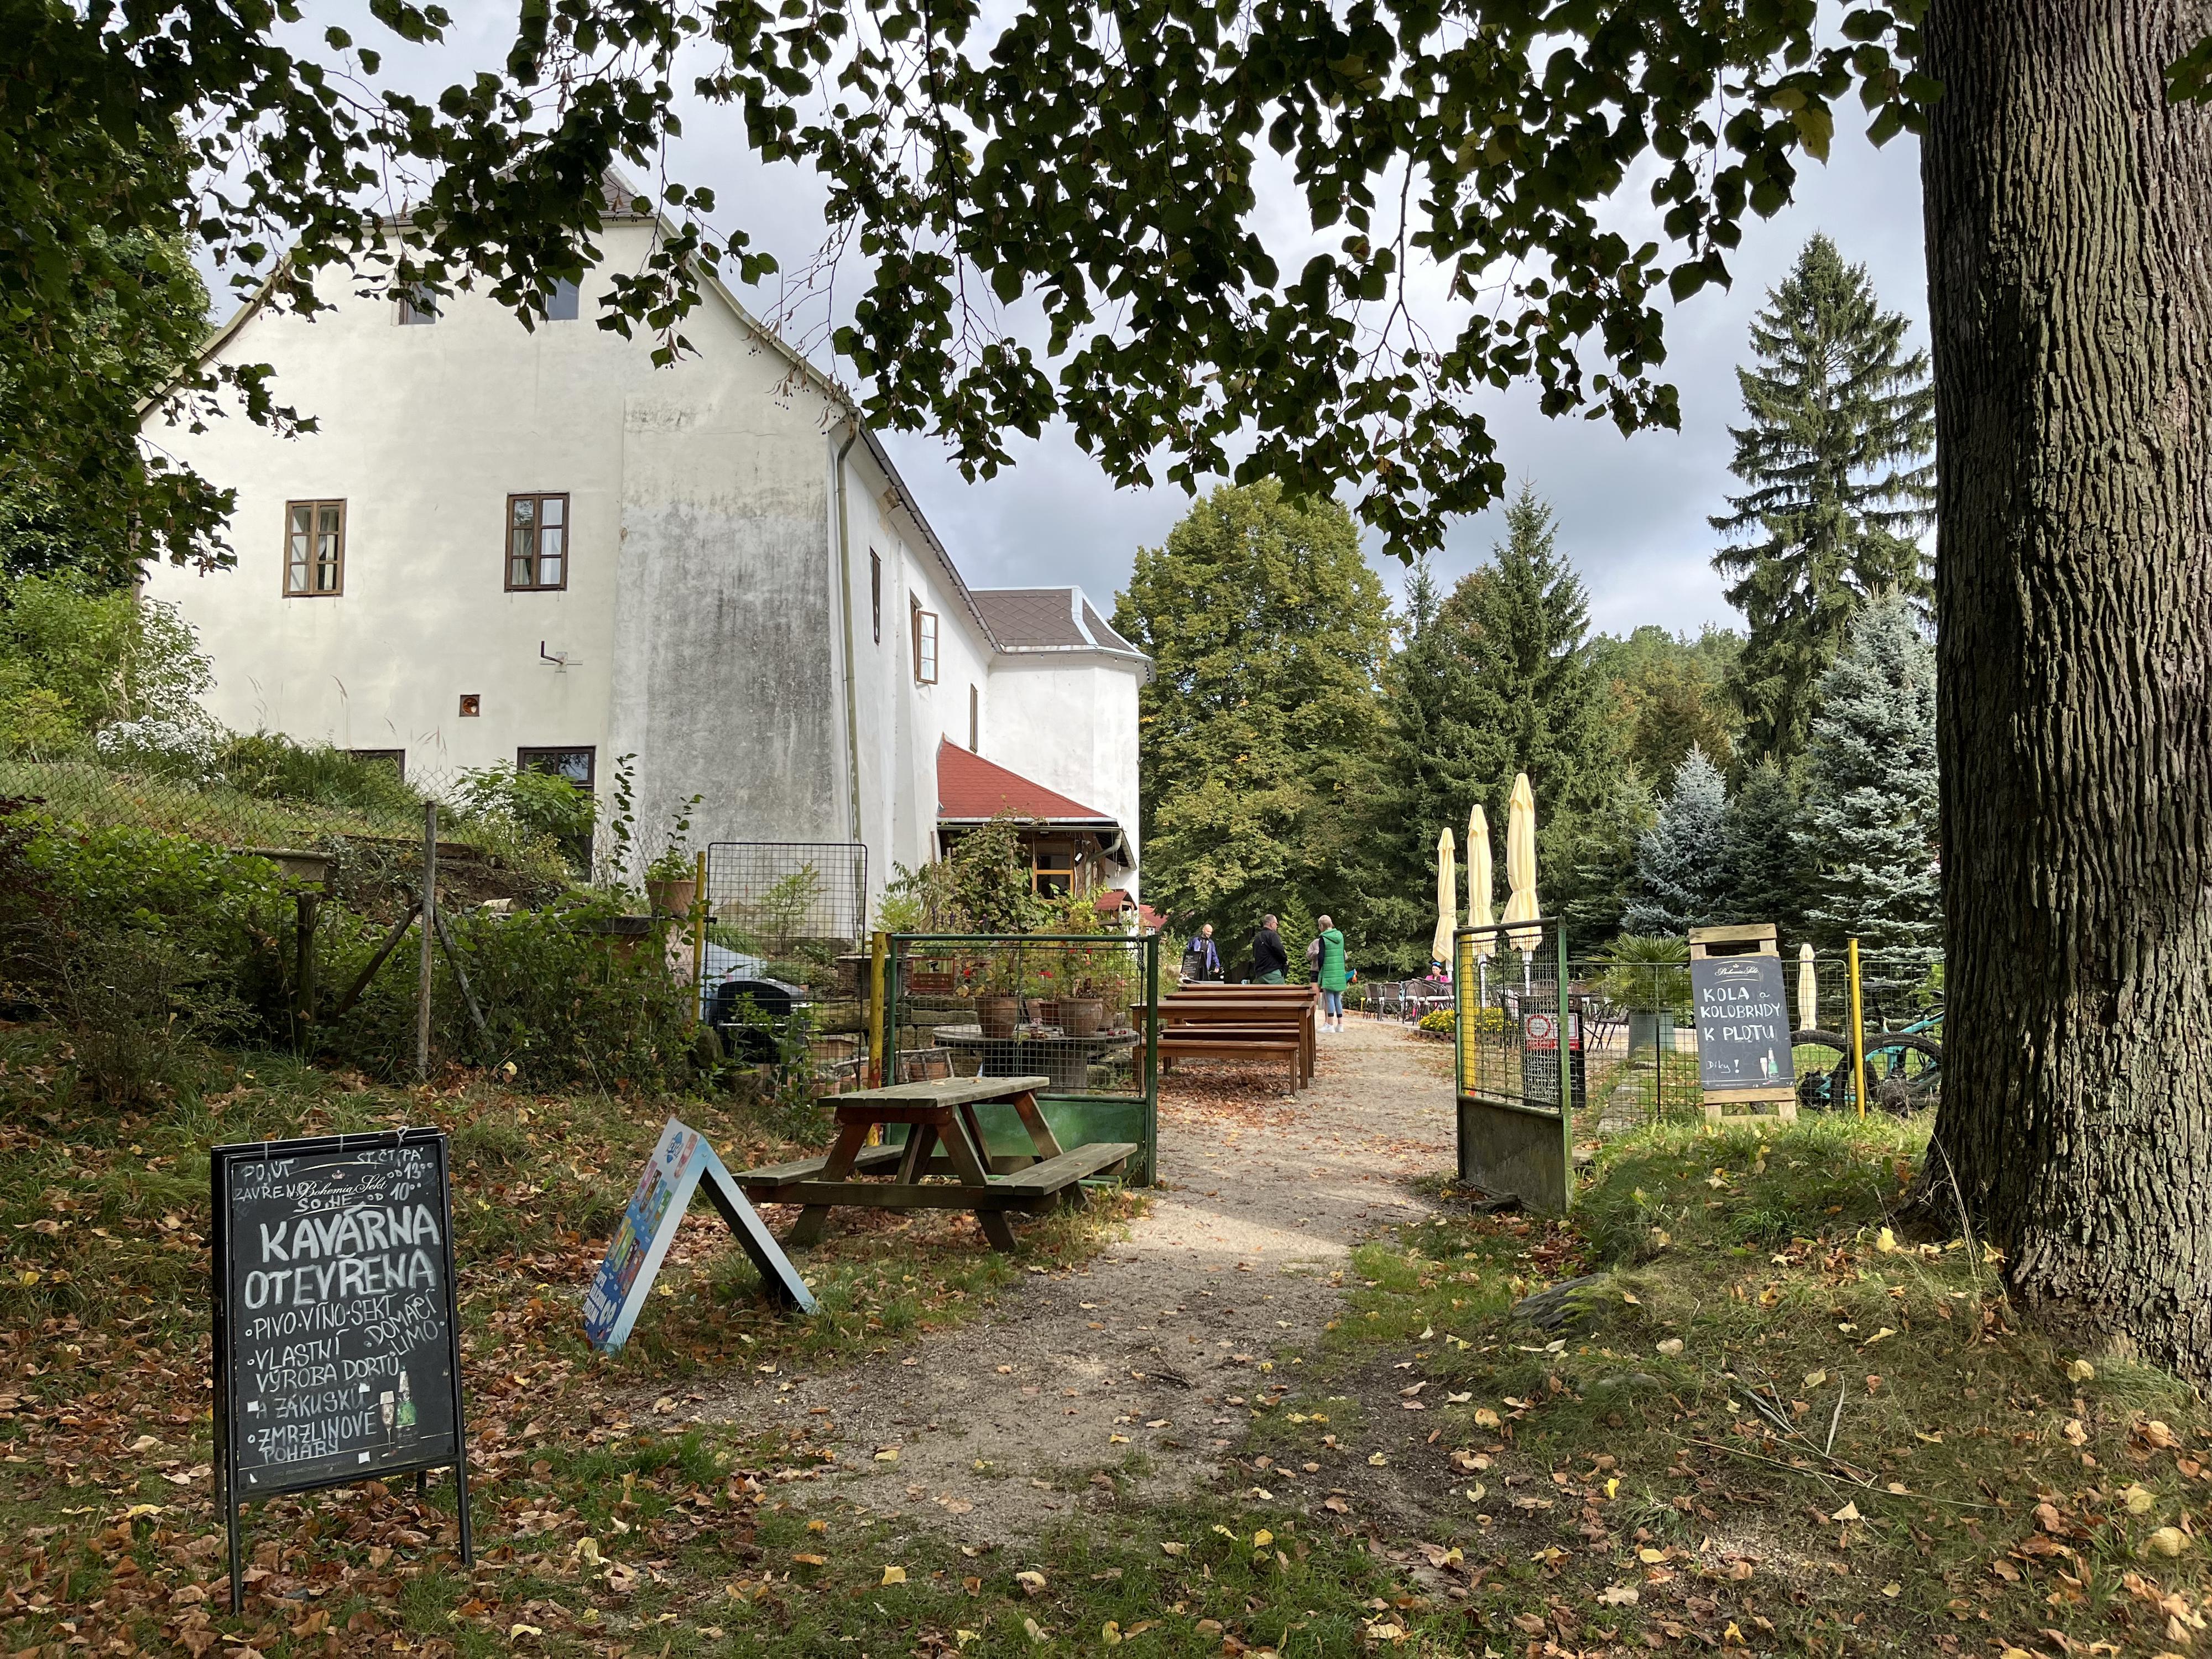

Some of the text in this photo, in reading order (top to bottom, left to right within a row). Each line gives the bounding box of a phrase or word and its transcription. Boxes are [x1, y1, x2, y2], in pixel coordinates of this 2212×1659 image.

[1700, 1003, 1780, 1019] KOLOBRNDY
[1703, 987, 1750, 1002] KOLA
[1704, 1025, 1775, 1041] K PLOTU
[290, 1173, 387, 1201] Bohemia Sekt
[259, 1201, 440, 1263] KAVÁRNA
[244, 1249, 437, 1310] OTEVŘENA
[255, 1328, 349, 1371] VLASTNÍ
[390, 1320, 439, 1355] LIMO
[255, 1350, 399, 1394] VÝROBA DORTŮ
[258, 1397, 379, 1452] ZMRZLINOVÉ
